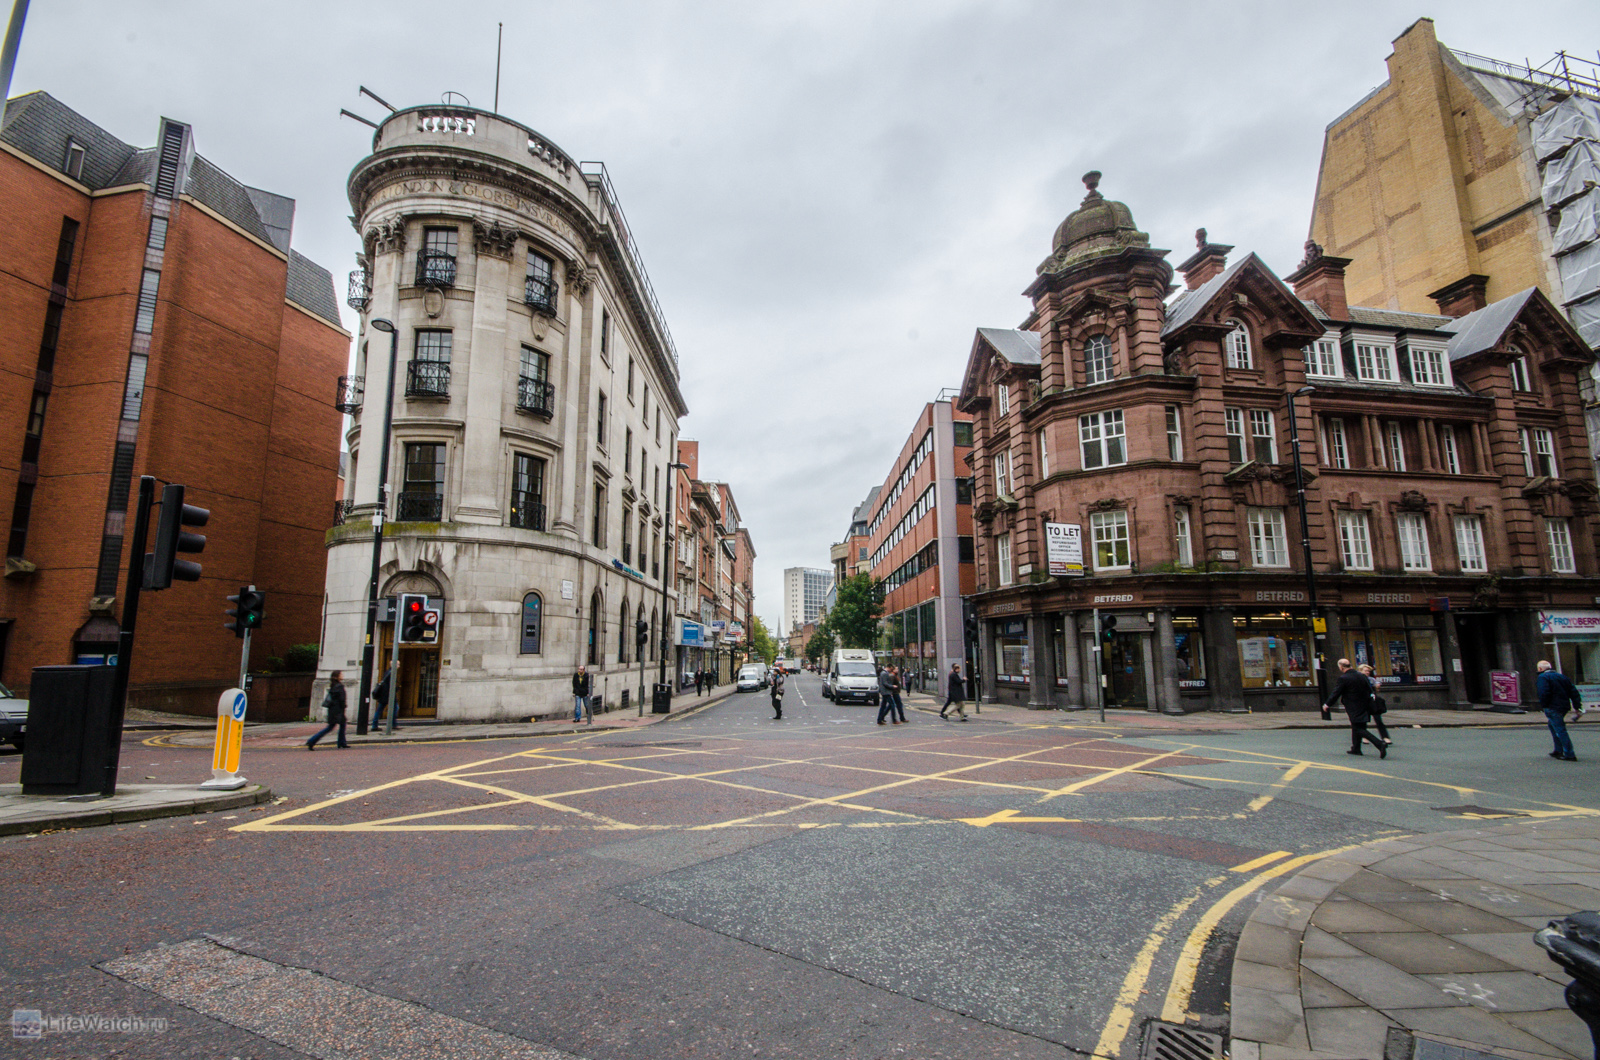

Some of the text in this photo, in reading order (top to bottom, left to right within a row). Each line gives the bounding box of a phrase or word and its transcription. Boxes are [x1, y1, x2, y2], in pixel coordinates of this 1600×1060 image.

[389, 181, 443, 197] LONDON
[449, 181, 459, 195] &
[463, 182, 514, 207] GLOBE
[1048, 527, 1079, 536] TO LET
[1094, 594, 1134, 603] BETFRED
[1256, 591, 1304, 602] BETFRED
[1367, 592, 1412, 603] BETFRED
[993, 602, 1015, 613] BETFRED
[1179, 680, 1206, 688] BETFRED
[1417, 675, 1441, 683] BETFRED
